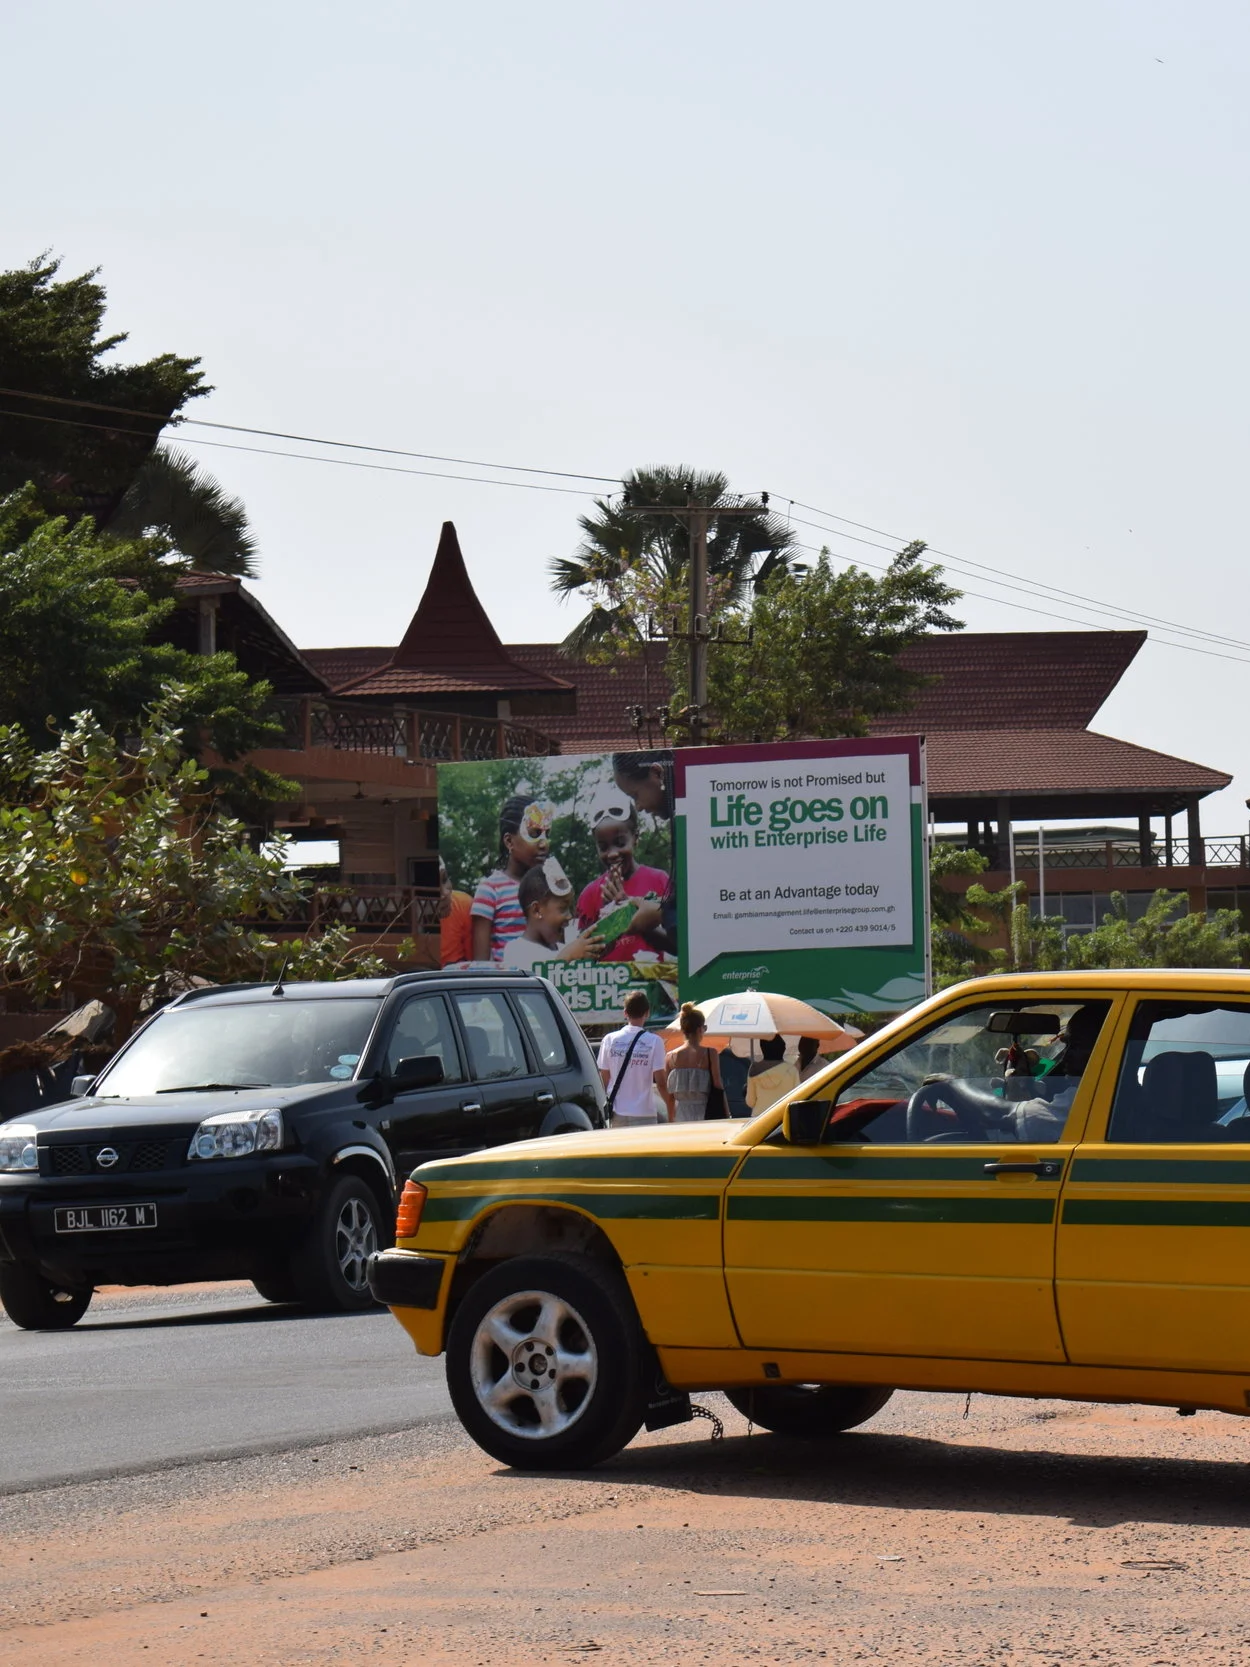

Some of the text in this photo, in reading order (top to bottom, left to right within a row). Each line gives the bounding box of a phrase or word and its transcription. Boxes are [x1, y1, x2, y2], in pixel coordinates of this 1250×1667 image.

[710, 771, 886, 792] Tomorrow is not Promised but
[710, 794, 889, 832] Life goes on
[710, 824, 887, 849] with Enterprise Life
[719, 883, 879, 901] Be at an Advantage today
[713, 912, 733, 920] Email:
[789, 927, 815, 935] Contact
[835, 925, 853, 933] +220
[855, 924, 868, 932] 439
[869, 923, 896, 933] 9014/5
[722, 970, 761, 980] enterprise
[595, 984, 648, 1009] Pla
[67, 1207, 145, 1228] BJL 1162 M
